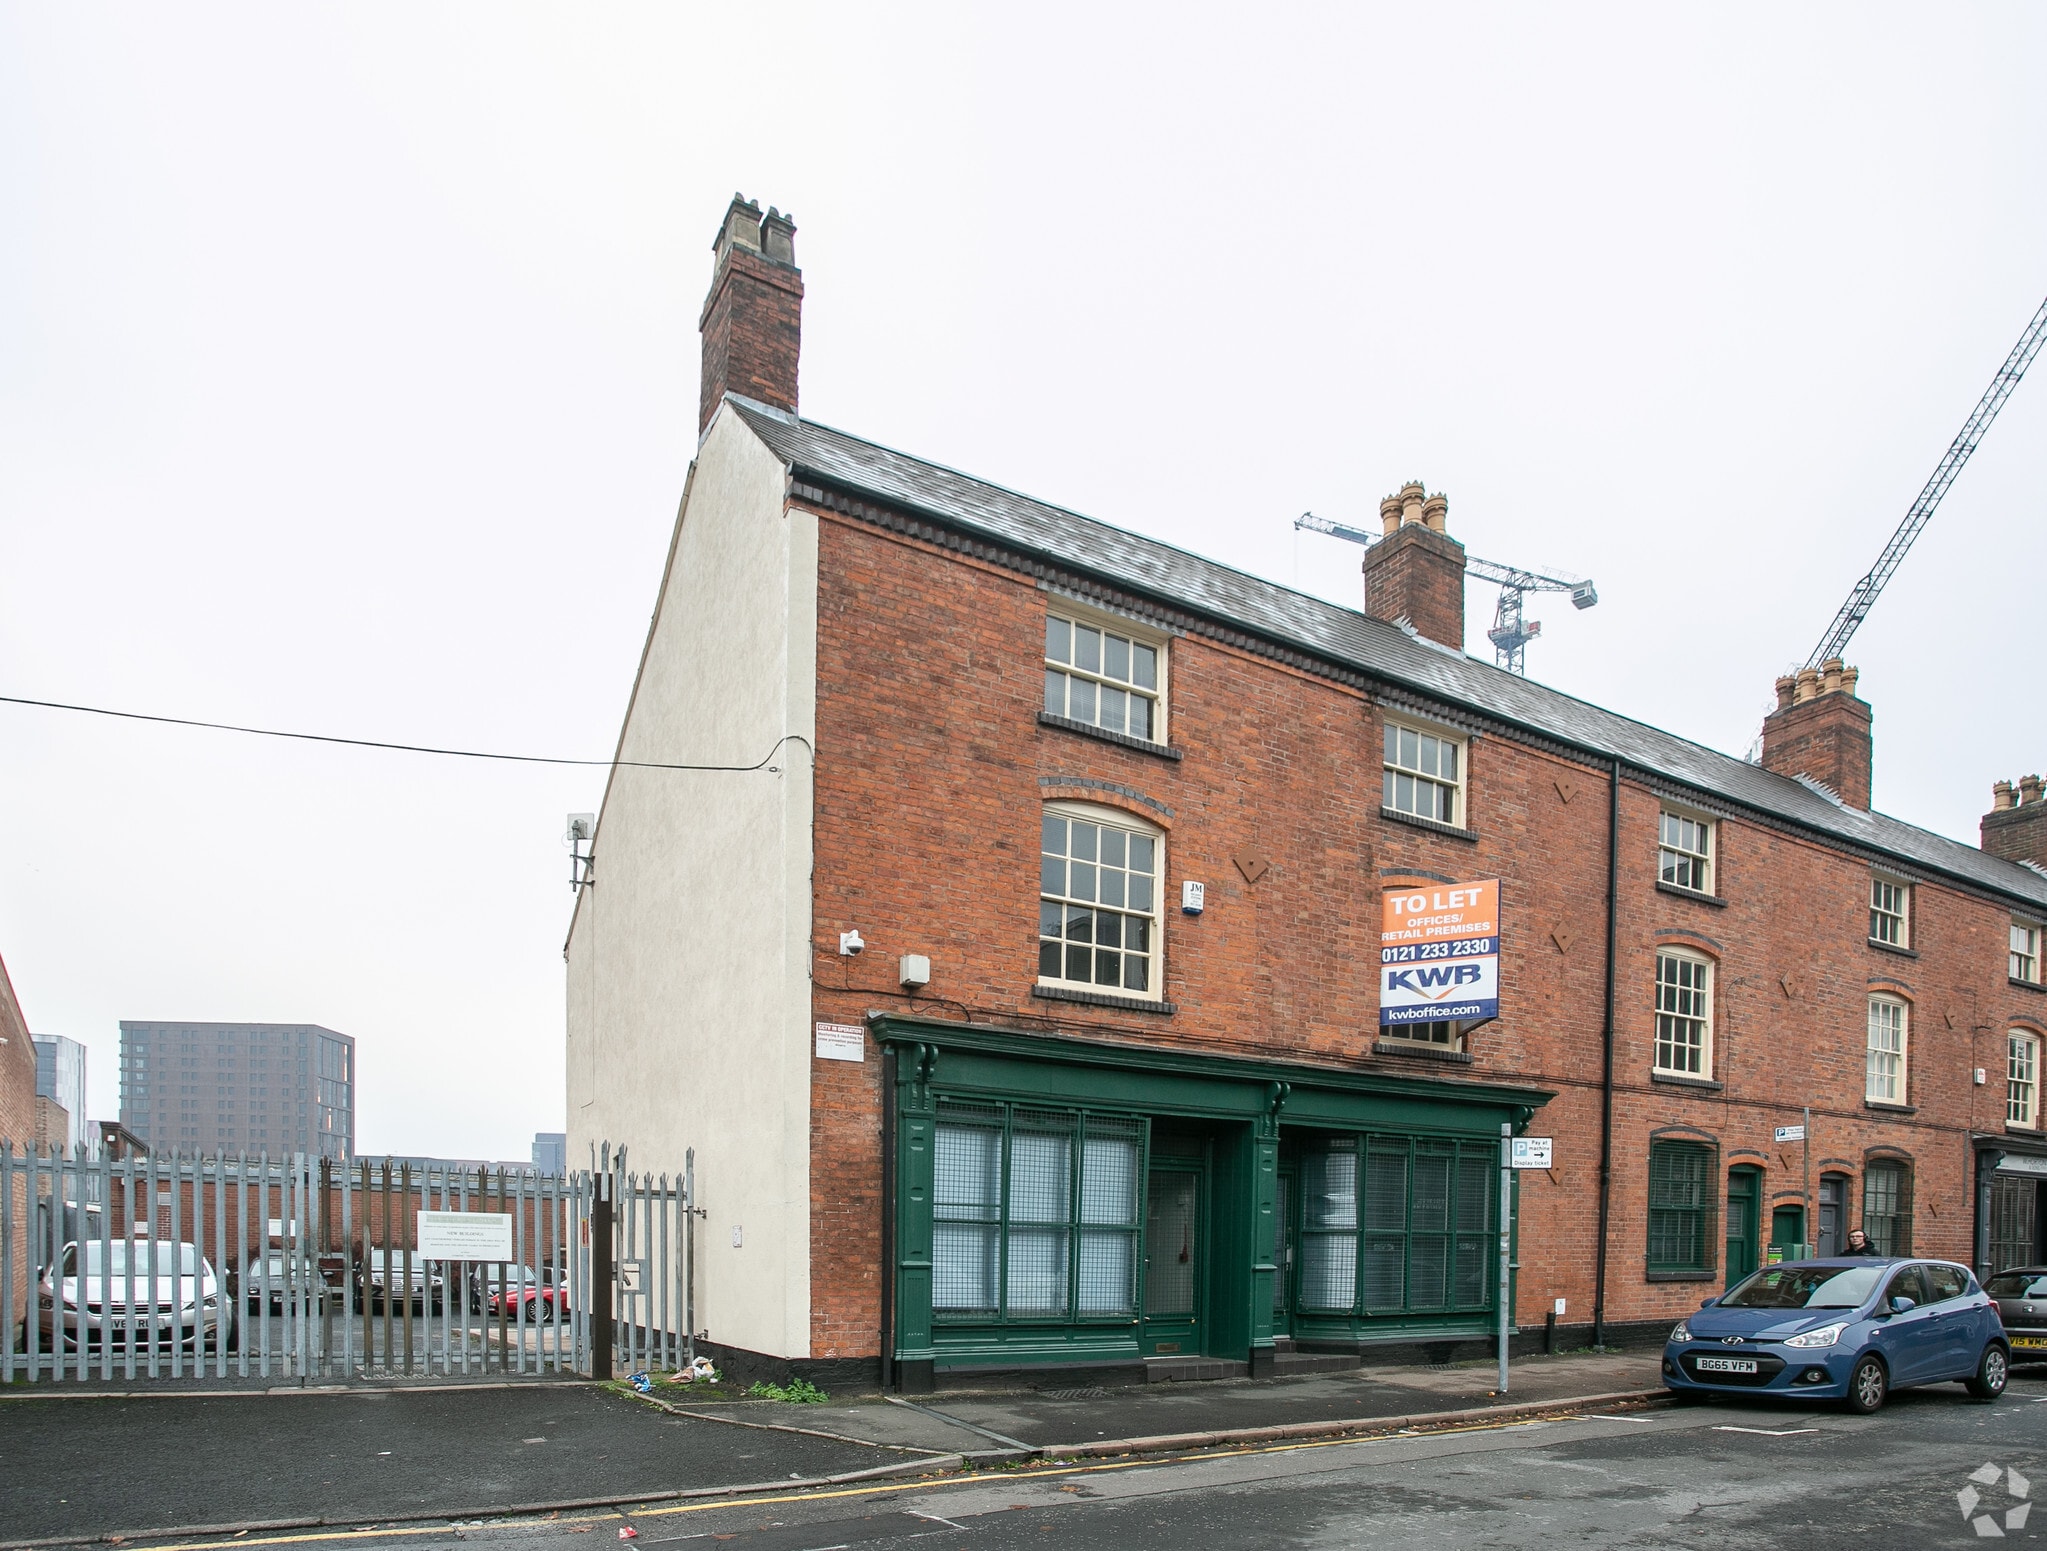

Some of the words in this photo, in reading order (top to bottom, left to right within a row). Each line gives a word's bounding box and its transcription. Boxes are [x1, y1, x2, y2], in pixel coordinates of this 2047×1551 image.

[1190, 883, 1202, 893] JM
[1390, 894, 1427, 915] TO
[1433, 888, 1483, 911] LET
[1407, 913, 1464, 928] OFFICES/
[1381, 930, 1424, 941] RETAIL
[1426, 921, 1491, 937] PREMISES
[1382, 946, 1416, 963] 0121
[1421, 942, 1449, 960] 233
[1452, 938, 1490, 957] 2330
[1388, 964, 1482, 995] KWB
[1388, 1004, 1481, 1021] kwboffice.com
[1516, 1142, 1526, 1156] P
[1701, 1359, 1729, 1370] BG65
[1731, 1360, 1753, 1372] VFM
